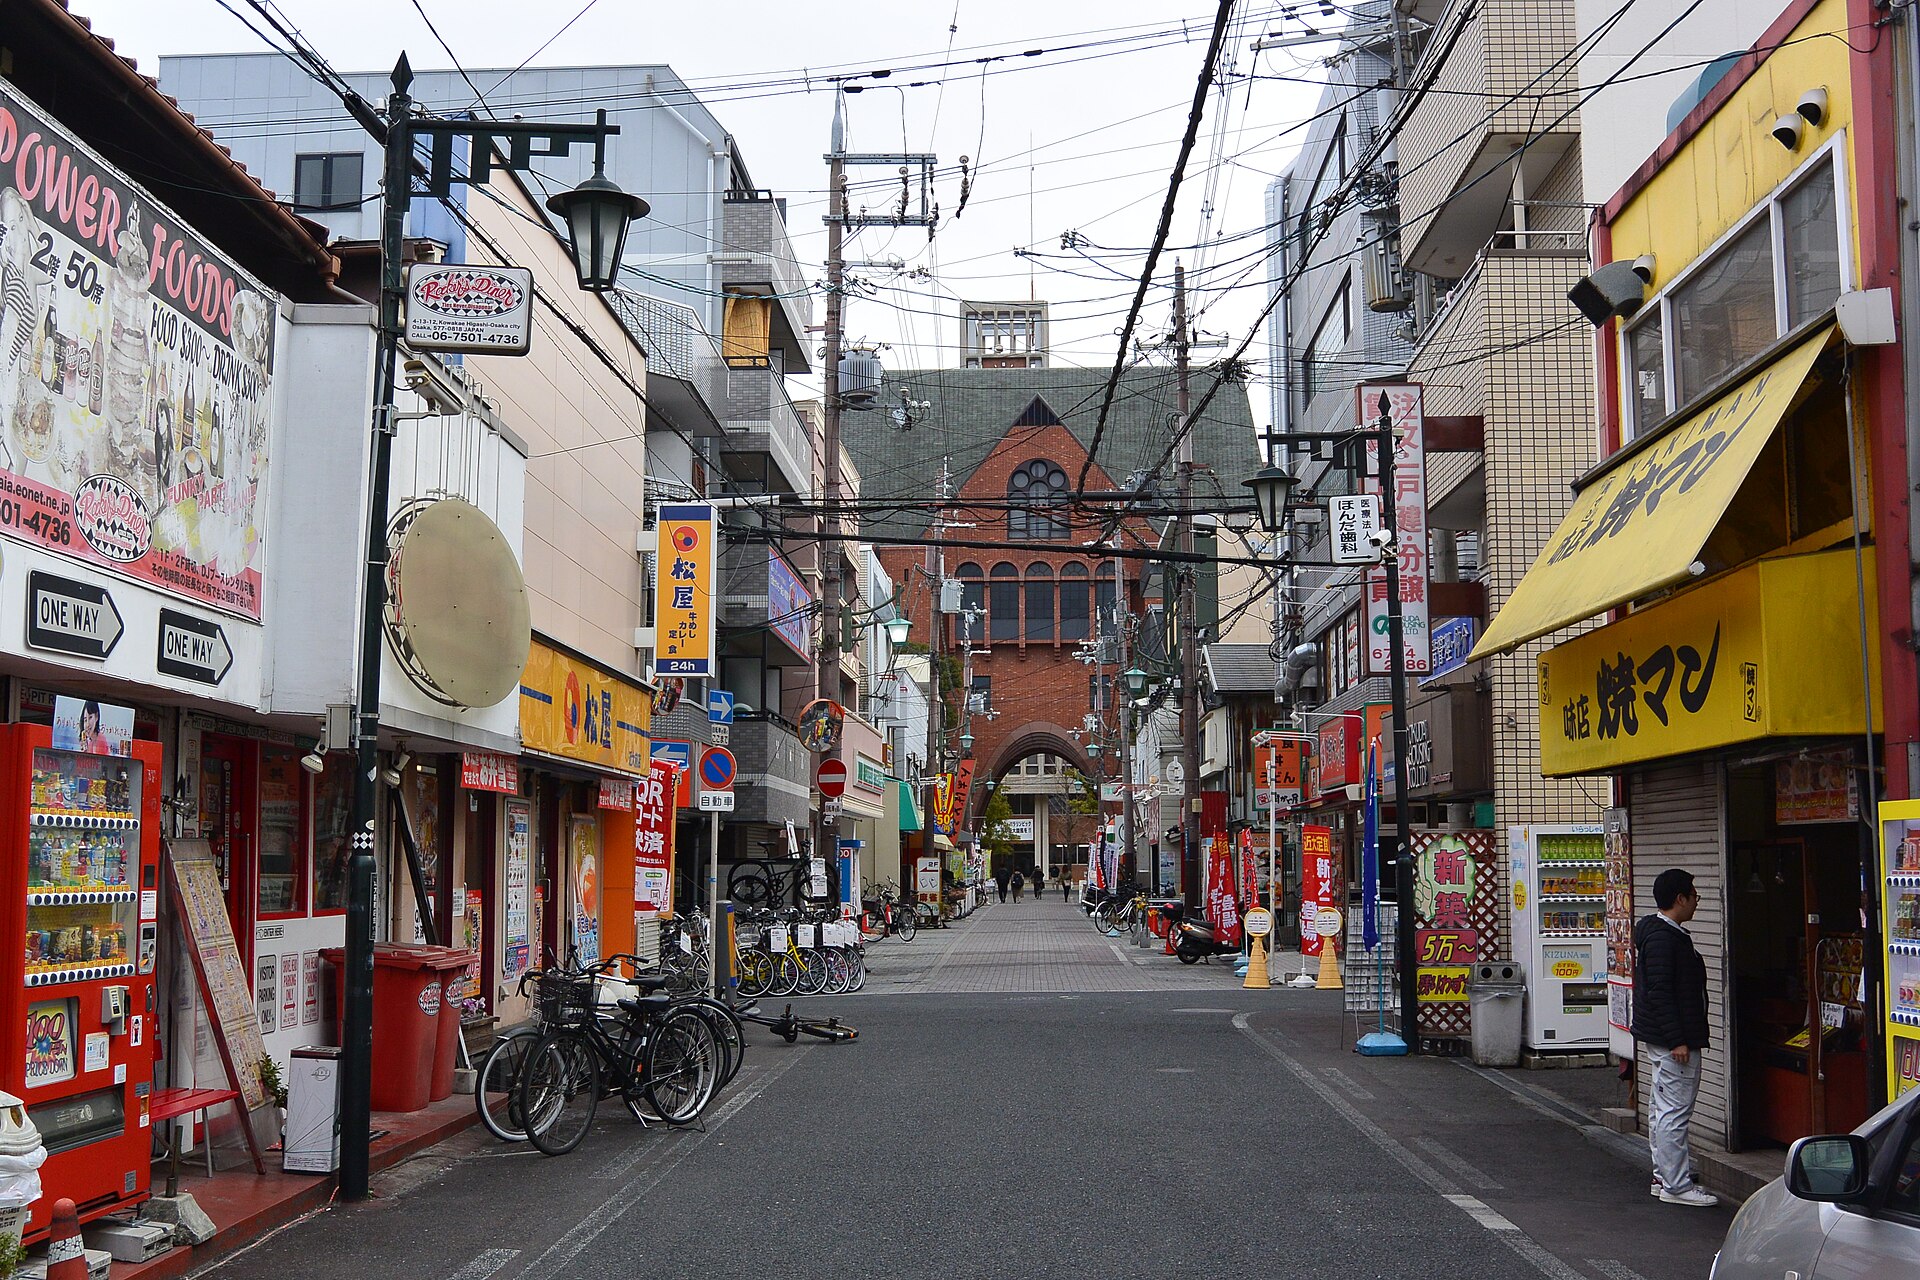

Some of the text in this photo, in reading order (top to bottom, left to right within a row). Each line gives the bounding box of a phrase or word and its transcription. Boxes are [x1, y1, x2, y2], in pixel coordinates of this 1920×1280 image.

[0, 106, 235, 337] POWER FOODS
[30, 232, 105, 305] 2階 50席
[472, 277, 514, 306] Diner
[150, 302, 178, 350] FOOD
[212, 343, 242, 391] DRINK
[432, 331, 519, 345] 06-7501-4736
[1627, 372, 1773, 480] YAKIMAN
[167, 473, 205, 507] FUNKY
[0, 498, 71, 546] 01-4736
[1338, 500, 1358, 554] ほんだ歯科
[1361, 499, 1372, 541] 医療法人
[671, 557, 697, 609] 松屋
[40, 596, 99, 634] ONE WAY
[688, 612, 697, 639] 牛めし
[166, 630, 214, 664] ONE WAY
[668, 629, 678, 654] 定食
[678, 621, 687, 648] カレー
[670, 661, 695, 671] 24h
[1372, 648, 1416, 659] 674
[1384, 659, 1427, 670] 286
[1562, 619, 1721, 742] 味店 焼マン
[583, 683, 612, 750] 松屋
[636, 780, 664, 807] QR
[701, 795, 733, 807] 自動車
[919, 893, 939, 902] 麻雀
[1434, 849, 1467, 928] 新築
[1544, 950, 1579, 959] KIZUNA
[259, 965, 275, 981] VISITOR
[1555, 968, 1579, 977] 100円
[258, 986, 275, 1003] PARKING
[26, 1010, 65, 1049] 100
[261, 1008, 273, 1025] ONLY
